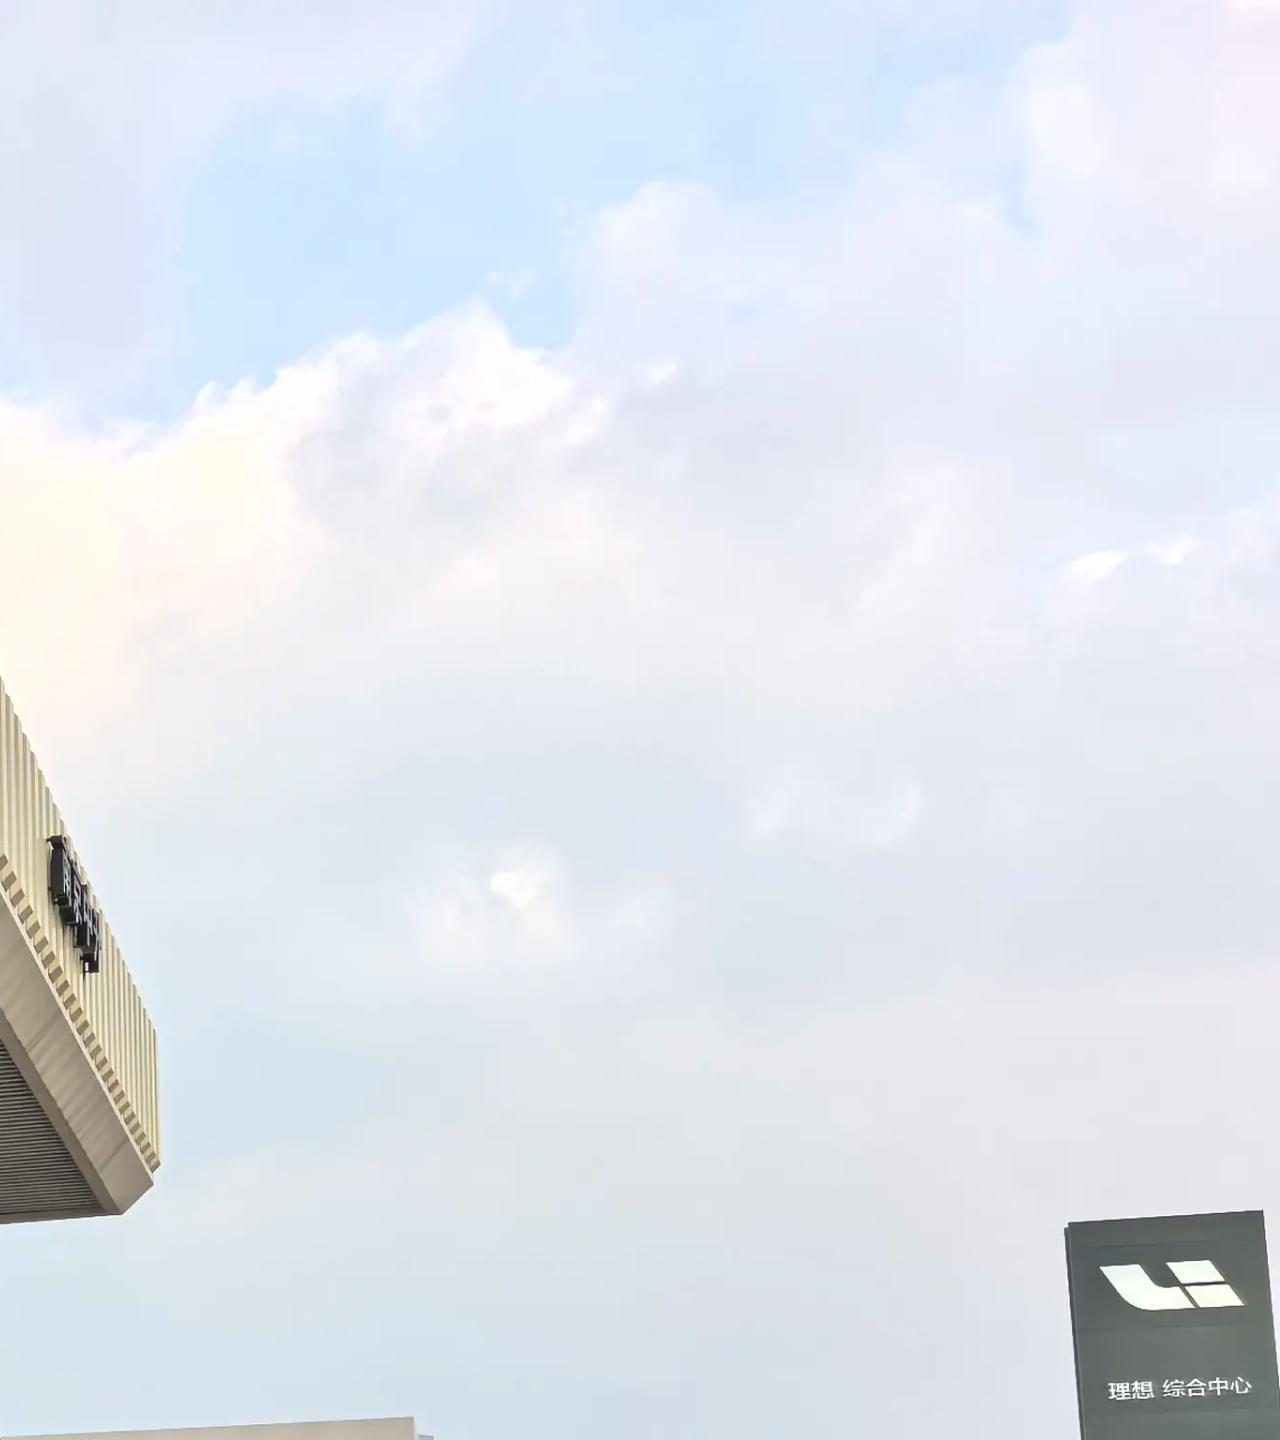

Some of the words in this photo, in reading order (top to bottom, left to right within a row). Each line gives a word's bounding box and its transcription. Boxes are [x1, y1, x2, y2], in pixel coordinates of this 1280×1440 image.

[1107, 1379, 1155, 1401] 理想
[1161, 1375, 1253, 1399] 综合中心
